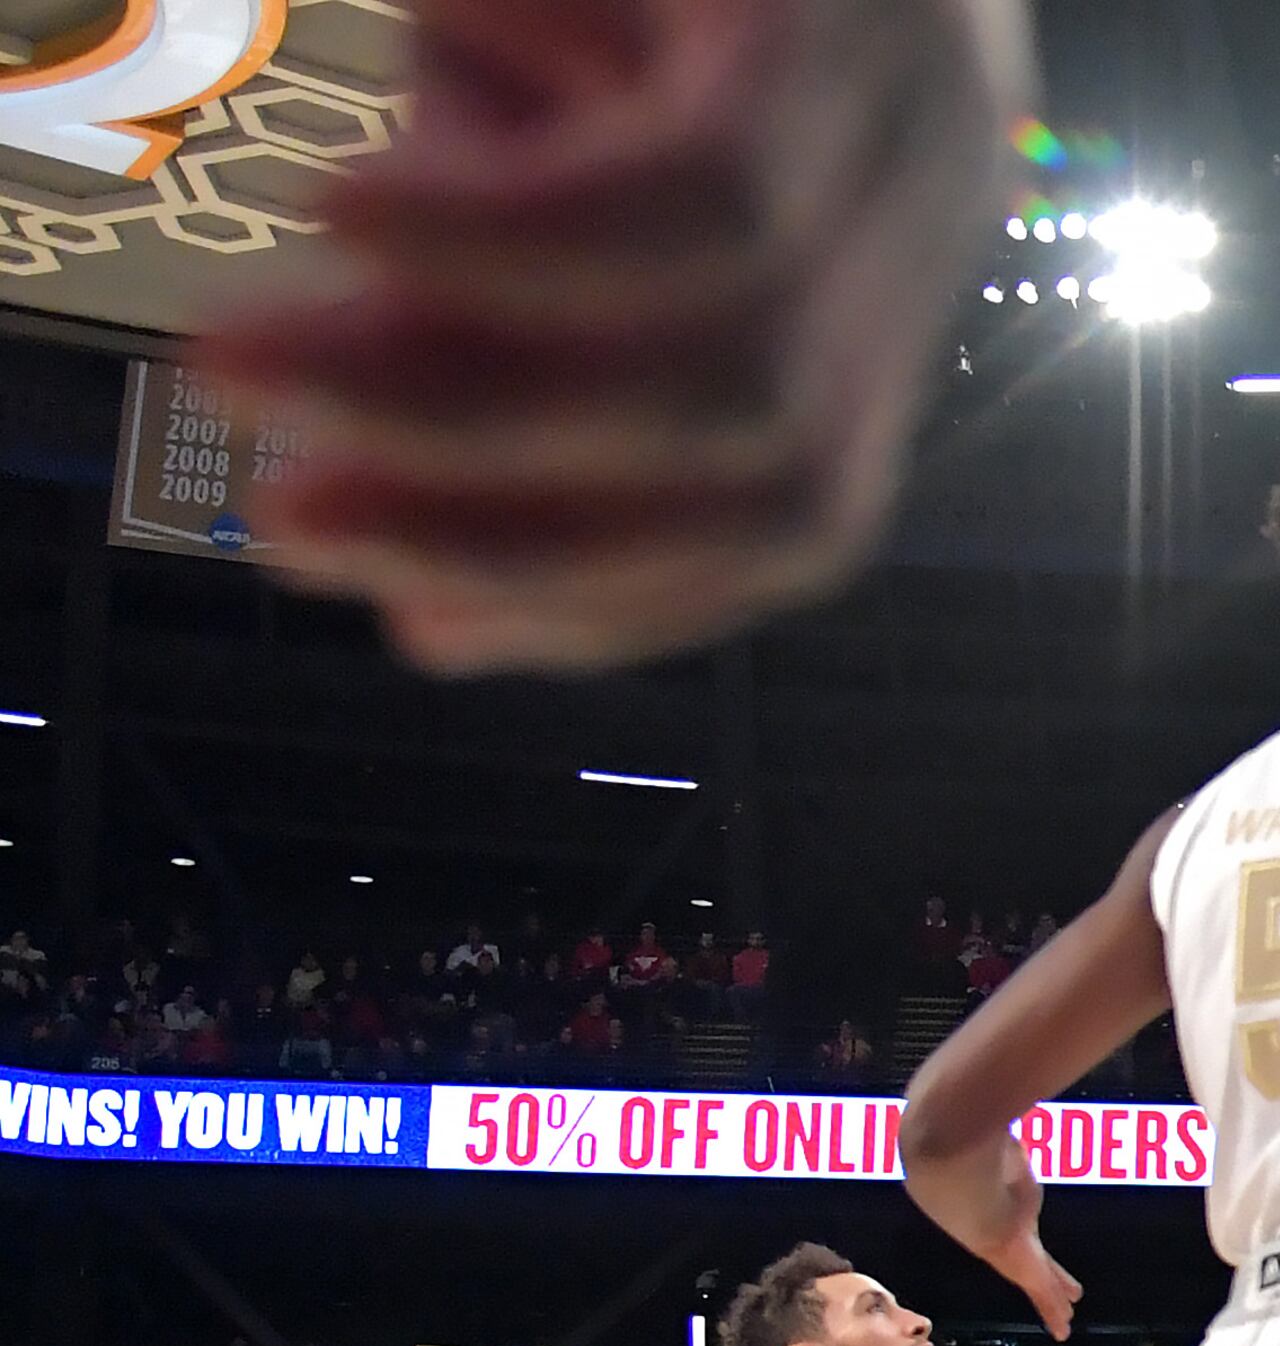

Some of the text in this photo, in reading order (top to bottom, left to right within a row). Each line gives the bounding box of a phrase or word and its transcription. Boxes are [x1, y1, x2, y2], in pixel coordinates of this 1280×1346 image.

[165, 414, 231, 447] 2007
[162, 444, 230, 477] 2008
[157, 474, 227, 507] 2009
[154, 1090, 264, 1150] YOU
[275, 1093, 402, 1155] WIN!
[465, 1092, 597, 1169] 50%
[618, 1095, 725, 1171] OFF
[1020, 1105, 1208, 1182] RDERS
